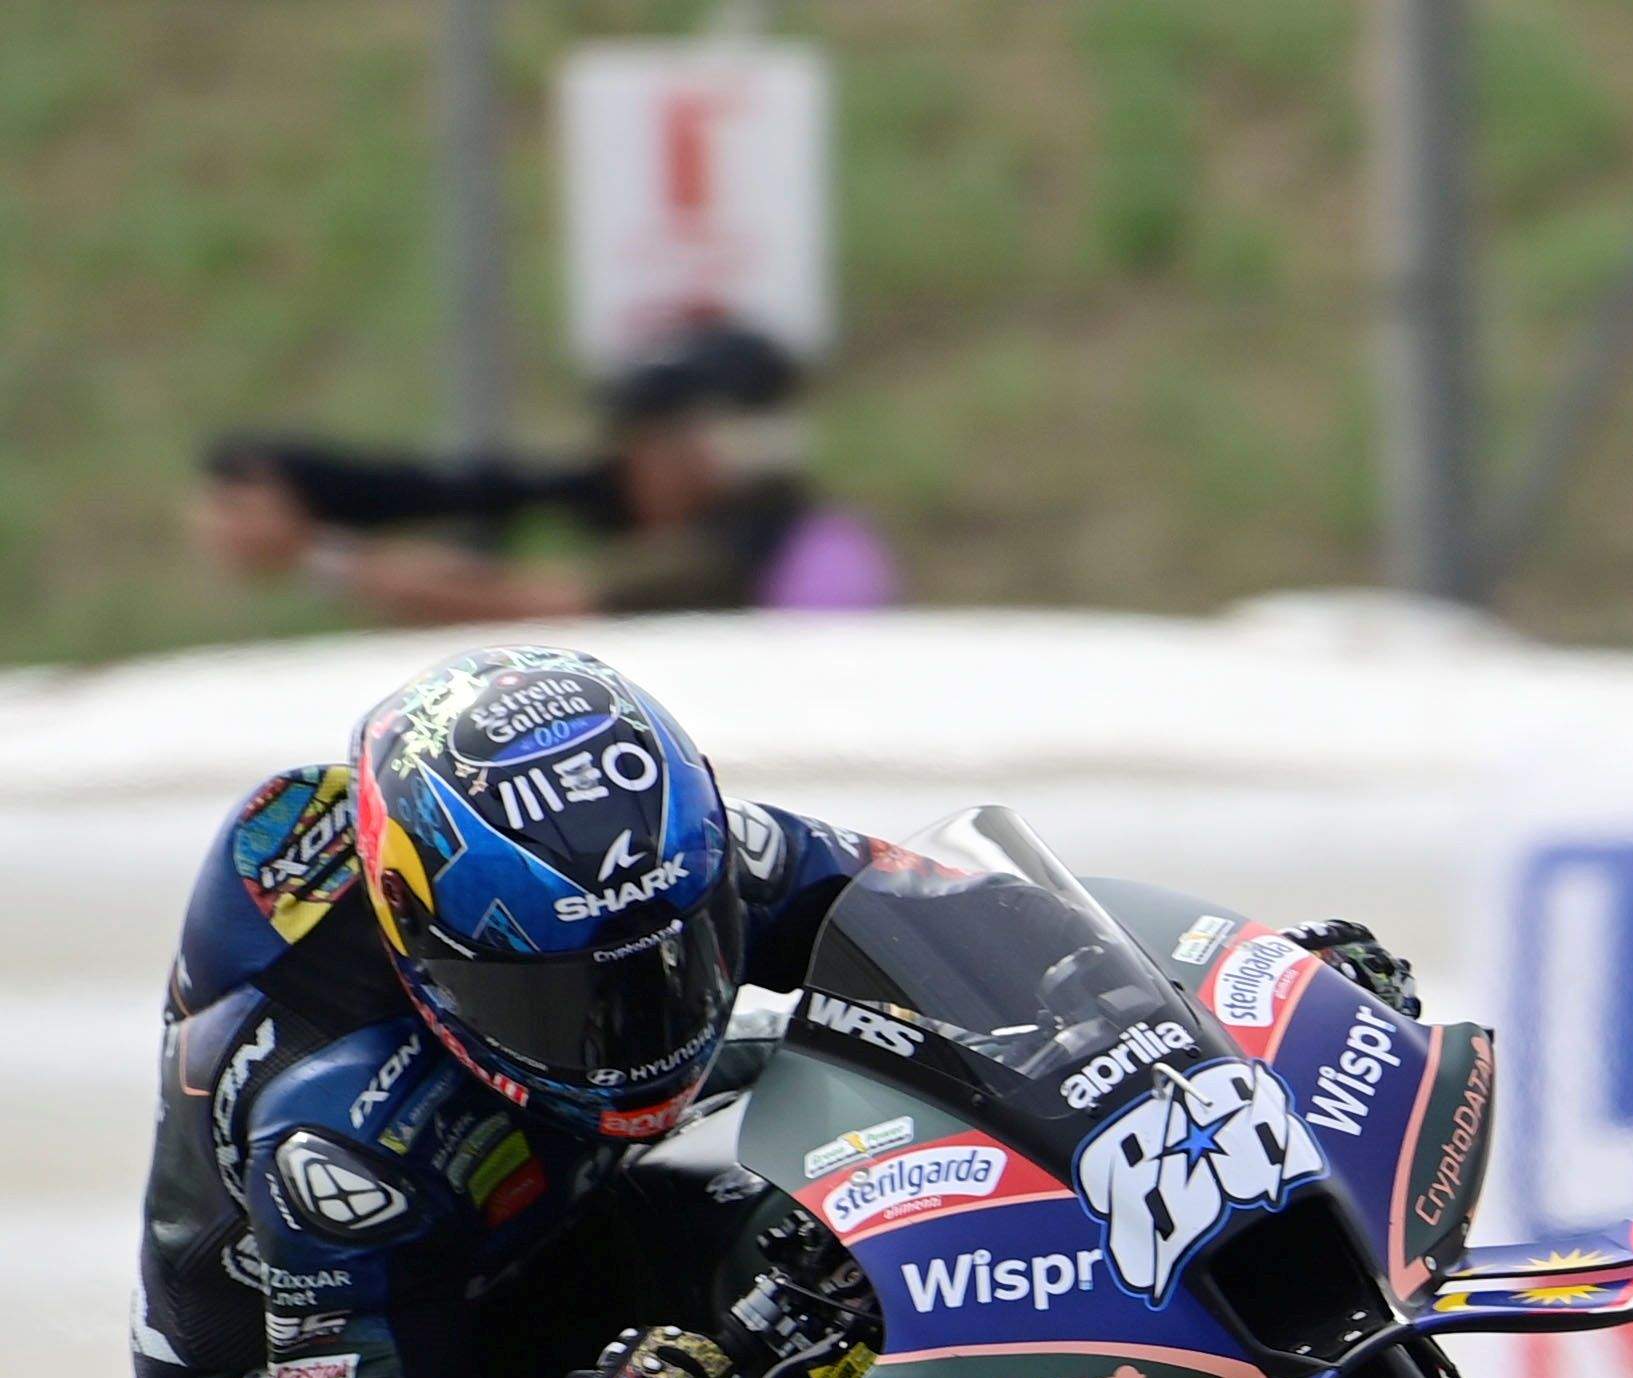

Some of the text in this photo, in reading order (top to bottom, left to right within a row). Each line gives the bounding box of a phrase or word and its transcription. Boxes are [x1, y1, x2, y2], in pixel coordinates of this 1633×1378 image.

[485, 694, 593, 744] Galicia
[553, 852, 690, 922] SHARK
[1228, 940, 1293, 1021] sterilgarda
[807, 991, 925, 1058] WRS
[1060, 1021, 1195, 1110] aprilia
[1306, 1005, 1401, 1136] Wispr
[1414, 1053, 1494, 1226] CryptoDATA
[834, 1150, 993, 1220] sterilgarda
[901, 1249, 1104, 1313] Wispr
